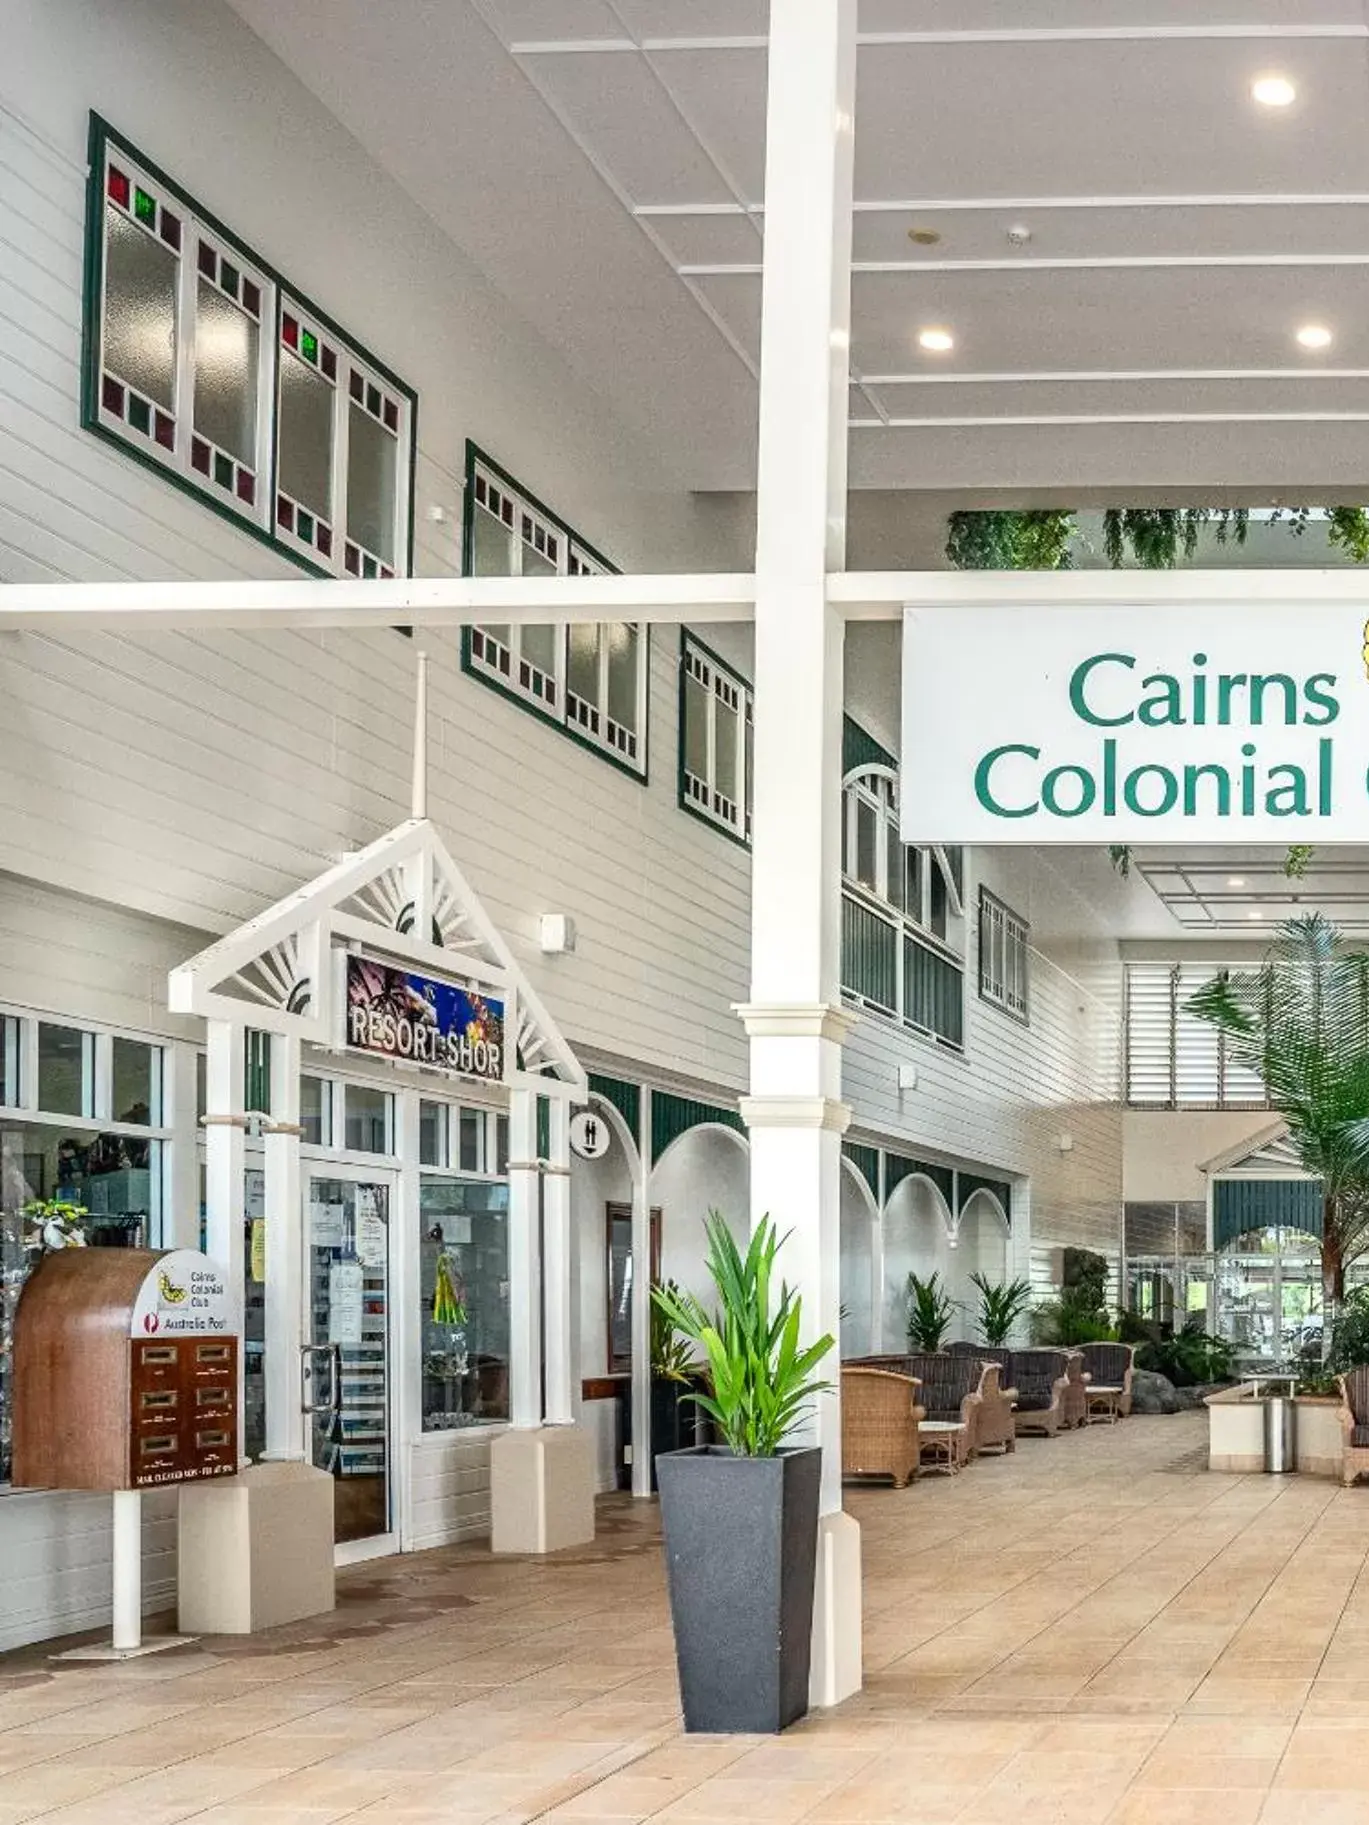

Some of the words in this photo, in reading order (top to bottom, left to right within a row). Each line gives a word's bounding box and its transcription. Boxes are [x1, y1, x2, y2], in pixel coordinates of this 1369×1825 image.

[1068, 652, 1341, 727] Cairns
[973, 737, 1333, 818] Colonial
[350, 1006, 441, 1062] RESORT
[447, 1031, 501, 1078] SHOP
[164, 1318, 206, 1329] Australia
